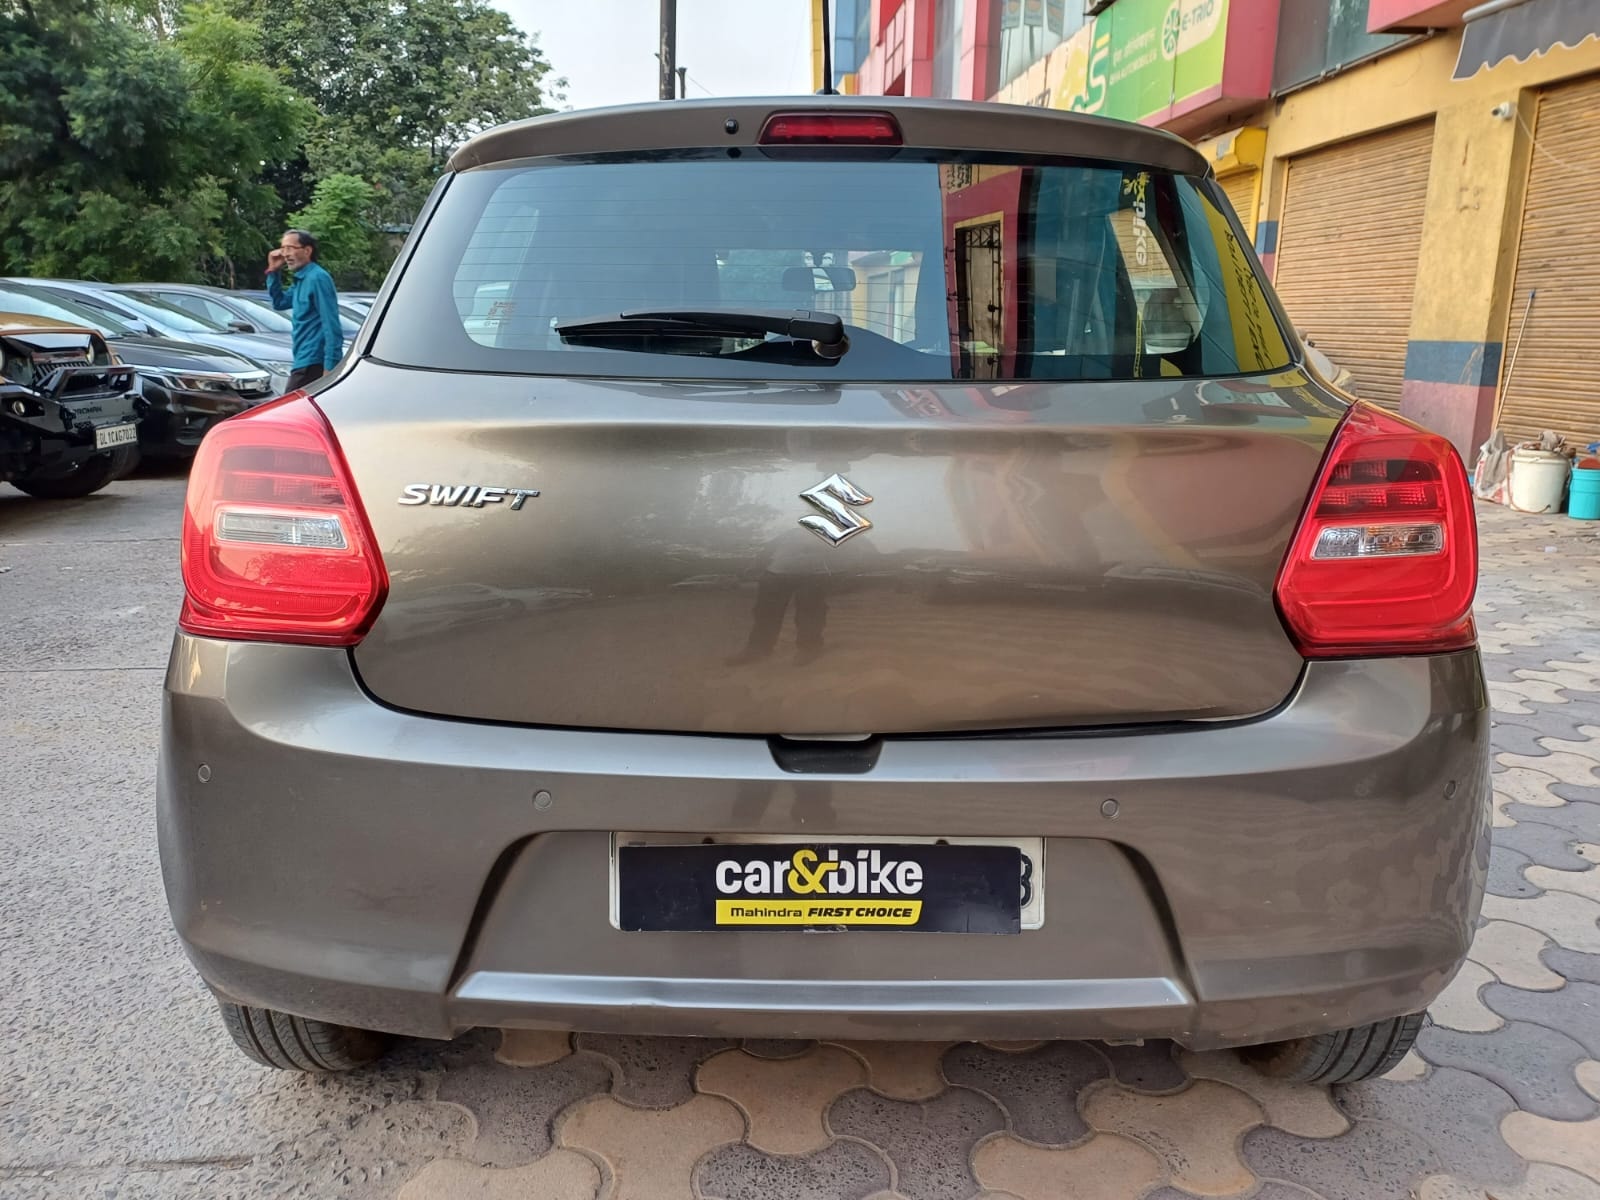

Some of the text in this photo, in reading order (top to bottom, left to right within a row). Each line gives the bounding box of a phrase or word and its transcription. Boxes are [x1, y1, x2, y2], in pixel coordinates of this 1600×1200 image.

[398, 483, 541, 511] SWIFT
[715, 849, 924, 895] car&bike
[730, 907, 913, 918] Mahindra FIRST CHOICE
